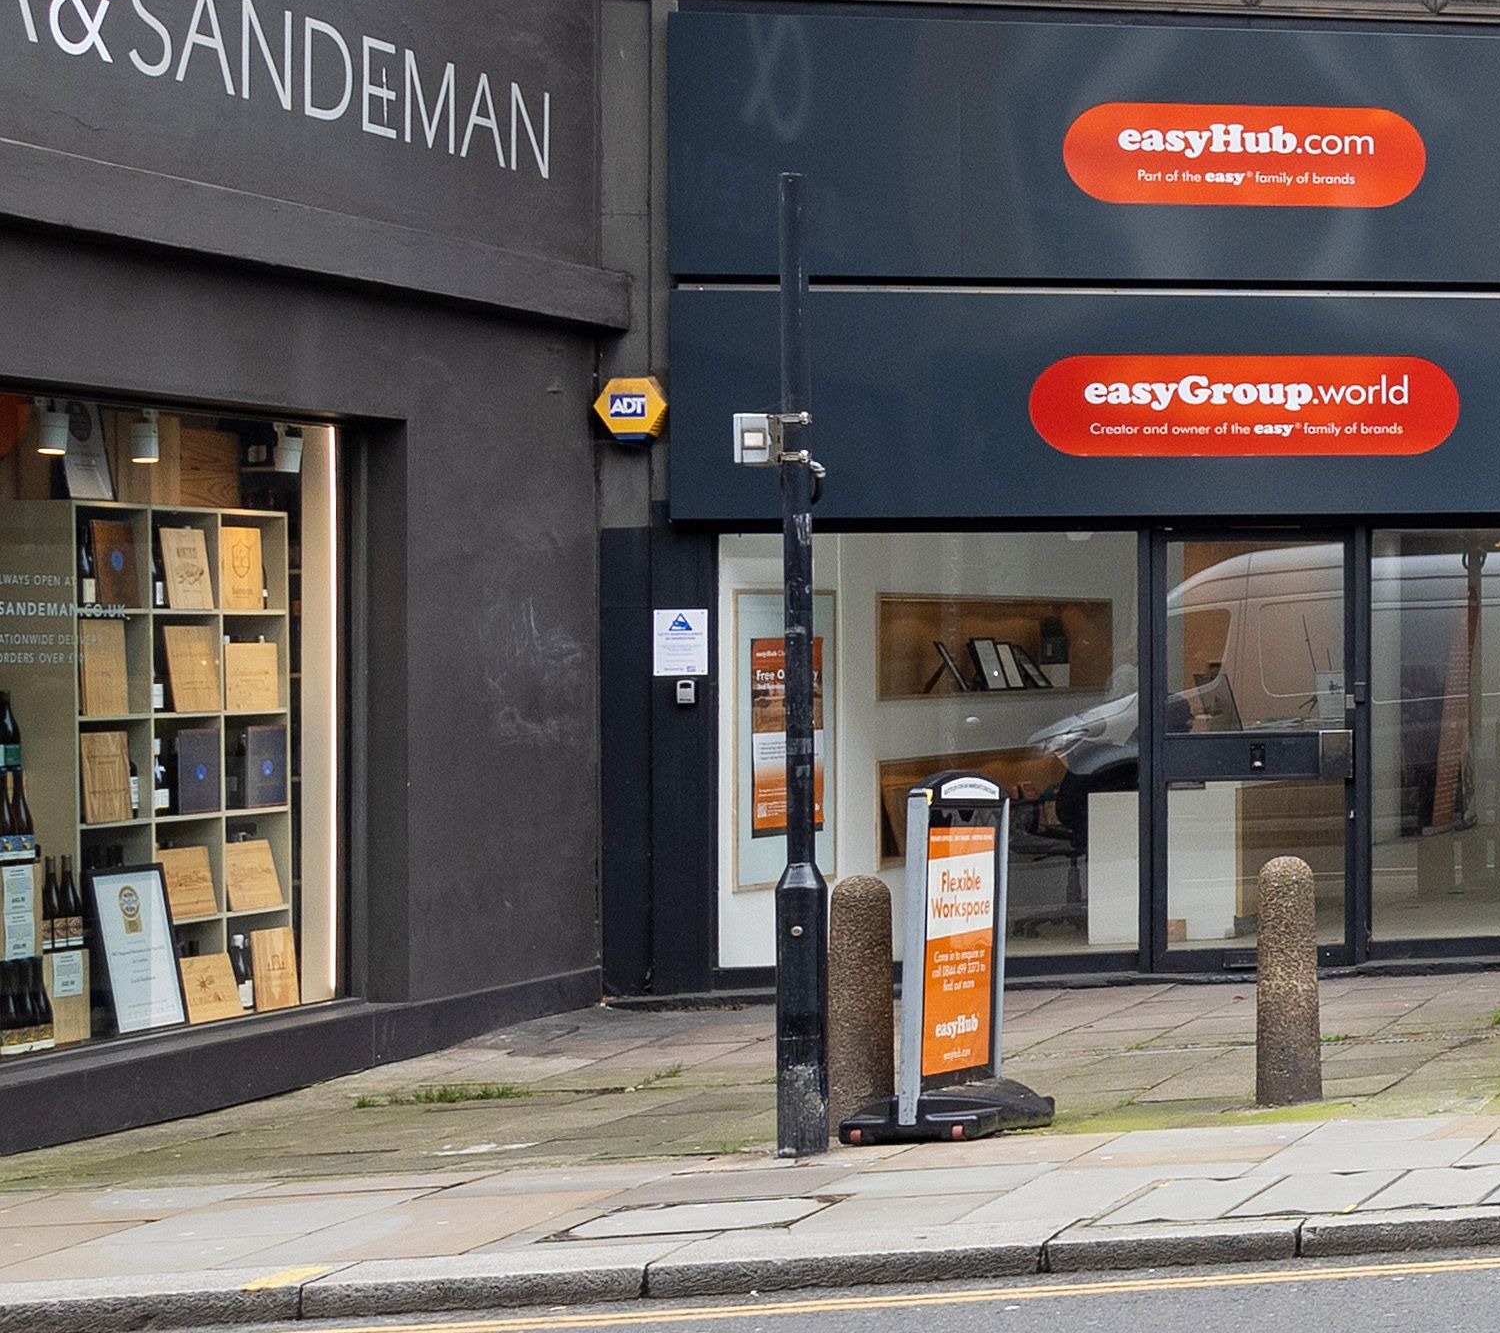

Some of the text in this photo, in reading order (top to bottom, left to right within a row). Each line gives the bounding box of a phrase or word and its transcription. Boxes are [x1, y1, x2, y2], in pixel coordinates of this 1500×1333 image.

[1117, 123, 1375, 159] easyHub.com
[1137, 169, 1162, 182] Part
[1165, 169, 1180, 182] of
[1182, 169, 1202, 182] the
[1255, 172, 1293, 185] family
[1296, 172, 1309, 185] of
[1312, 172, 1356, 185] brands
[1084, 374, 1409, 412] easyGroup.world
[609, 393, 647, 418] ADT
[1089, 422, 1140, 434] Creator
[1143, 422, 1168, 434] and
[1172, 425, 1211, 434] owner
[1214, 422, 1228, 434] of
[1231, 422, 1250, 434] the
[1303, 422, 1341, 437] family
[1344, 423, 1358, 435] of
[1360, 422, 1404, 435] brands
[33, 575, 61, 587] OPEN
[39, 653, 65, 664] OVER
[756, 669, 775, 681] Free
[941, 868, 982, 893] Flexible
[931, 895, 991, 923] Workspace
[934, 950, 949, 963] Come
[943, 978, 954, 991] find
[935, 1014, 979, 1039] easyHub
